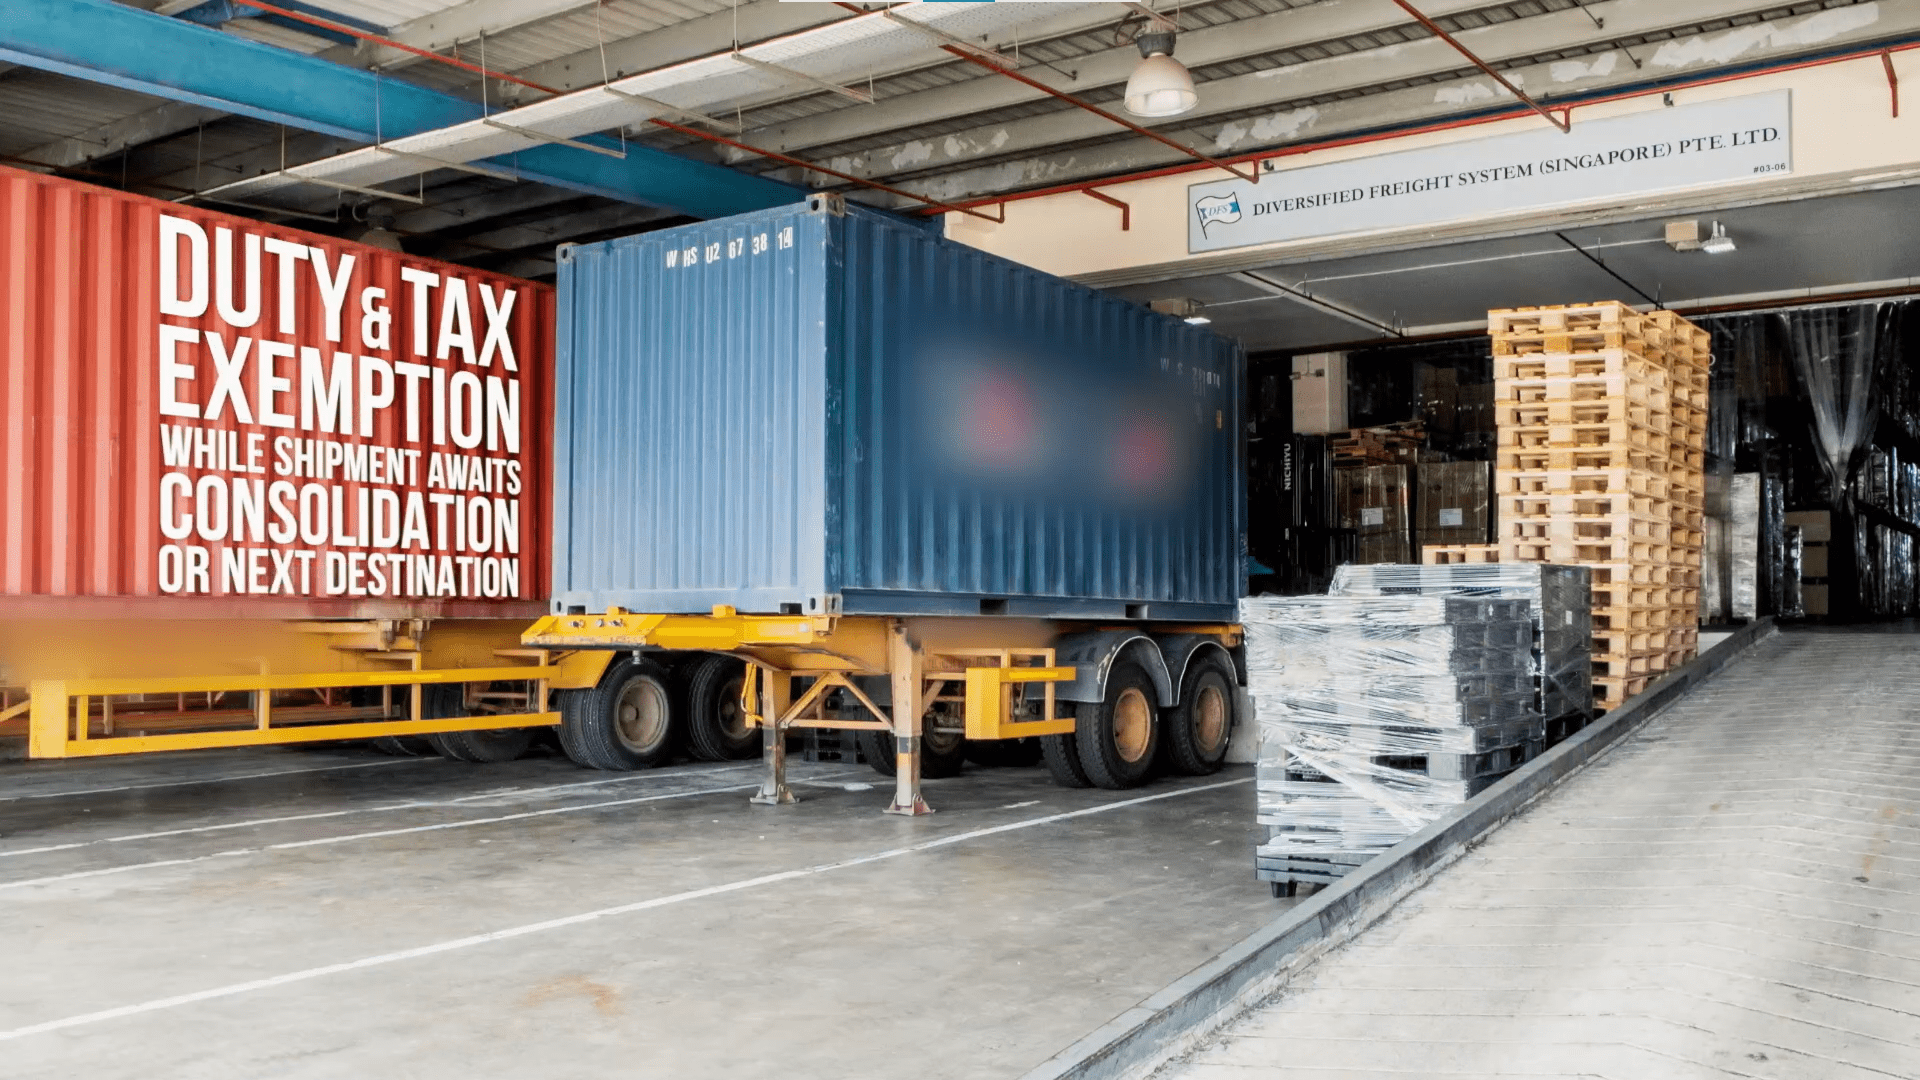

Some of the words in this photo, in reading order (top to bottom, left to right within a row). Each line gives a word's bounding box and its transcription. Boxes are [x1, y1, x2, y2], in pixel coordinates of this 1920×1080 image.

[1252, 187, 1365, 216] DIVERSIFIED
[1368, 174, 1454, 199] FREIGHT
[1457, 163, 1533, 186] SYSTEM
[1539, 142, 1673, 175] (SINGAPORE)
[1679, 133, 1727, 155] PTE.
[1731, 126, 1780, 147] LTD.
[1753, 162, 1787, 174] #03-06
[1207, 204, 1229, 217] DFS
[1283, 443, 1291, 491] NICHIYU
